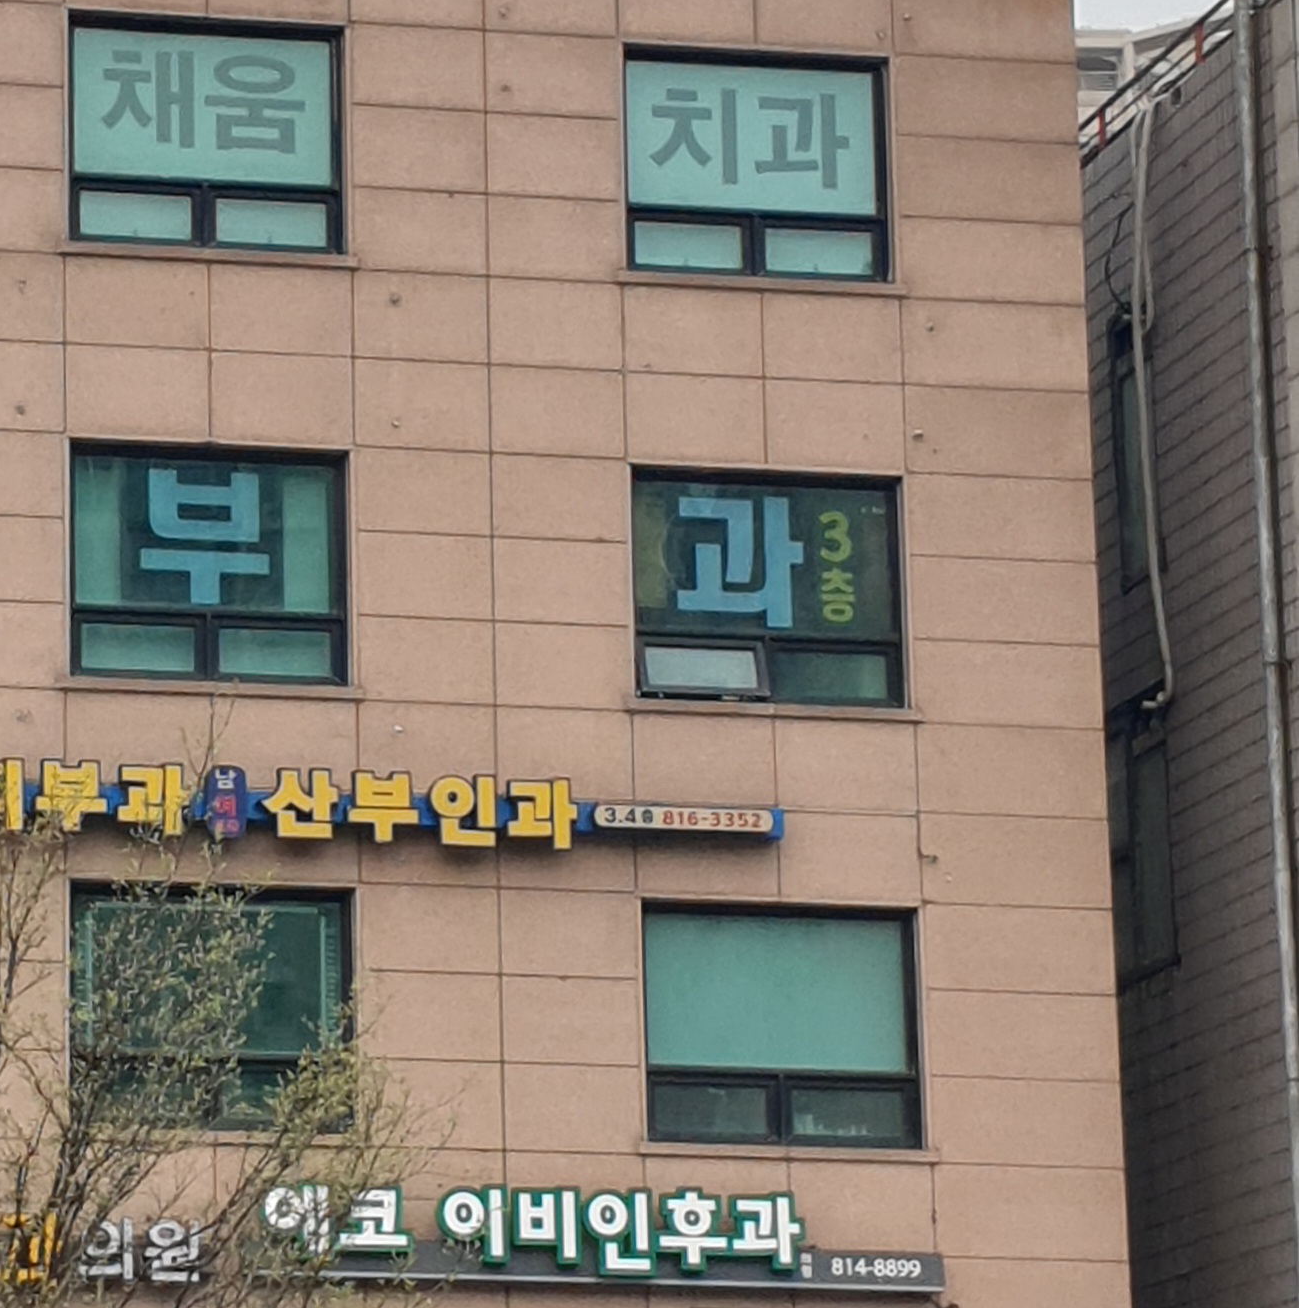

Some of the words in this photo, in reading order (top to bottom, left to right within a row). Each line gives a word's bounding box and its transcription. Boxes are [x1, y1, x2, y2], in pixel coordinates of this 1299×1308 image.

[101, 49, 306, 155] 채움
[649, 88, 850, 190] 치과
[260, 766, 578, 851] 산부인과
[662, 809, 763, 829] 816-3352
[439, 1185, 803, 1275] 이비인후과
[831, 1256, 922, 1278] 814-8899
